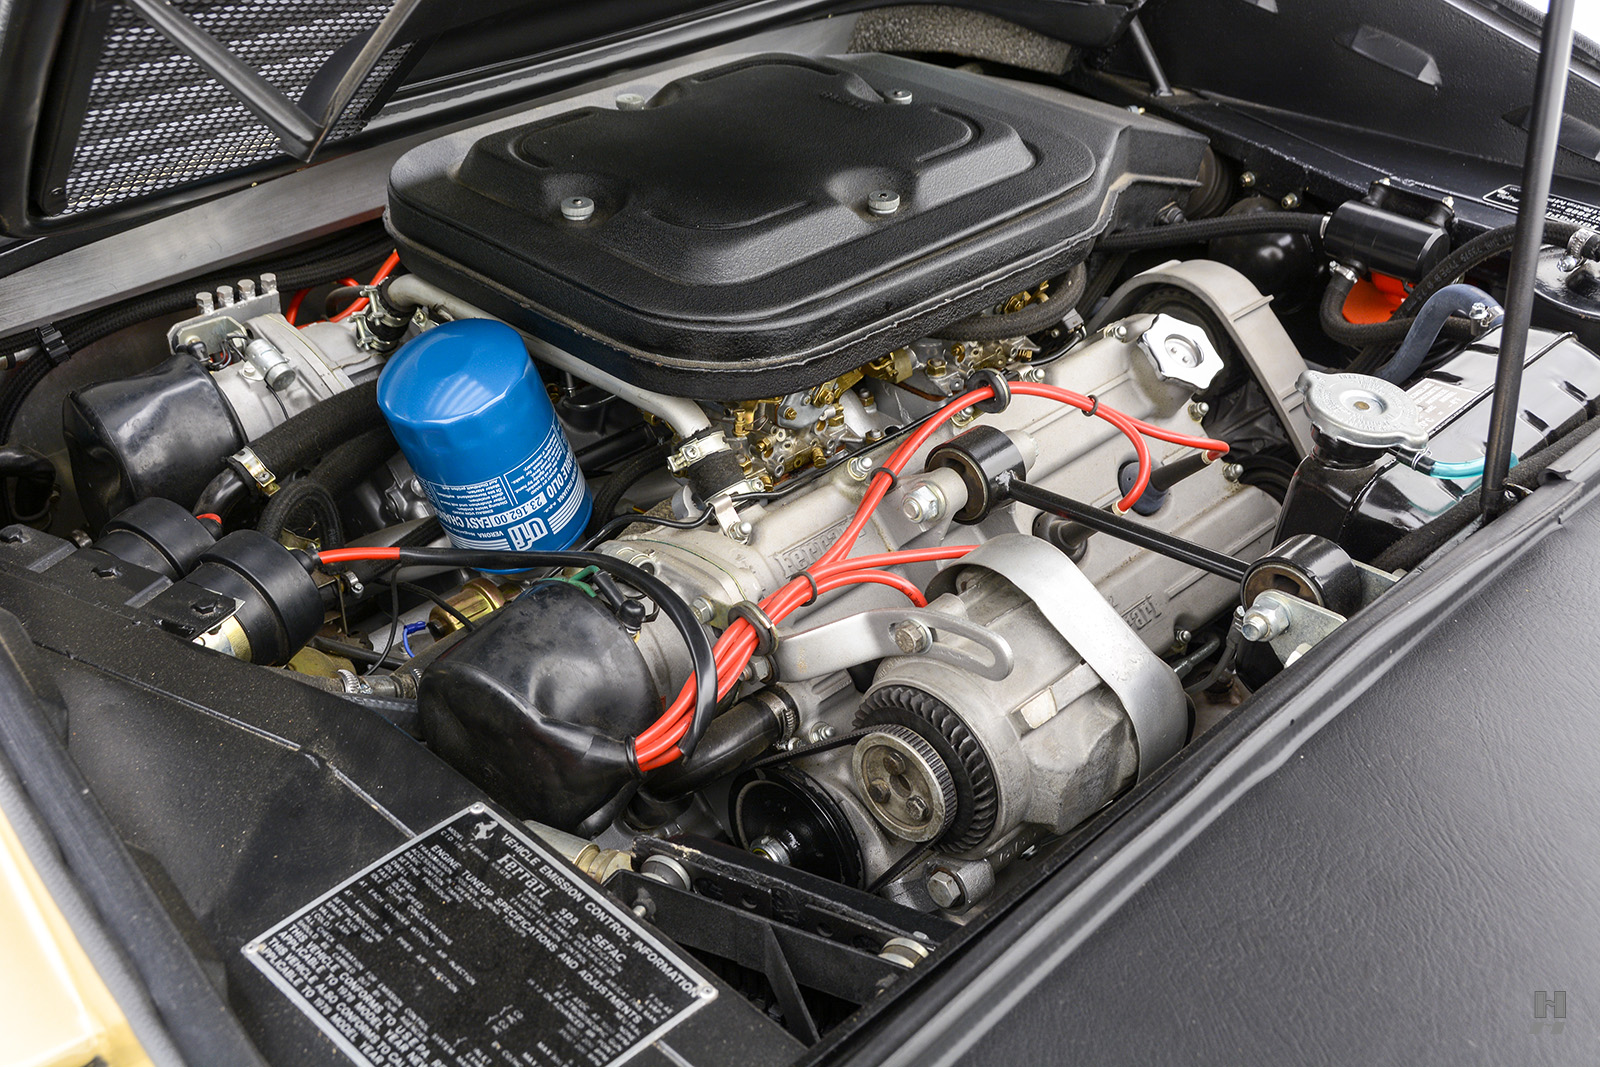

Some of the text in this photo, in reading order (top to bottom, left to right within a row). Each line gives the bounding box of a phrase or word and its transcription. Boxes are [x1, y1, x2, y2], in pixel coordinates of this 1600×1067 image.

[514, 484, 527, 493] hand.
[524, 469, 532, 477] for
[530, 483, 542, 495] HAND
[544, 473, 566, 499] OLIO
[465, 516, 491, 527] EASY
[493, 496, 542, 525] 23.162.00
[367, 888, 384, 903] EACH
[376, 868, 391, 880] FAST
[404, 893, 424, 909] SPEED
[495, 853, 628, 963] Ferrari spa SEFAC
[429, 844, 462, 870] ENGINE
[459, 869, 495, 898] TUNEUP
[492, 897, 559, 952] SPECIFICATIONS
[556, 951, 579, 969] AND
[576, 968, 644, 1024] ADJUSTMENTS
[499, 833, 703, 998] VEHICLE EMISSION CONTROL INFORMATION
[255, 942, 305, 987] APPLICABLE
[299, 984, 317, 998] TO
[328, 1012, 362, 1041] MODEL
[266, 936, 289, 956] THIS
[282, 952, 319, 984] VEHICLE
[313, 981, 340, 1004] ALSO
[333, 1001, 382, 1044] CONFORMS
[374, 1040, 393, 1055] TO
[276, 929, 326, 974] APPLICABLE
[322, 973, 339, 987] TO
[351, 1001, 386, 1031] MODEL
[381, 1029, 410, 1054] YEAR
[286, 923, 399, 1027] THIS VEHICLE CONFORMS TO
